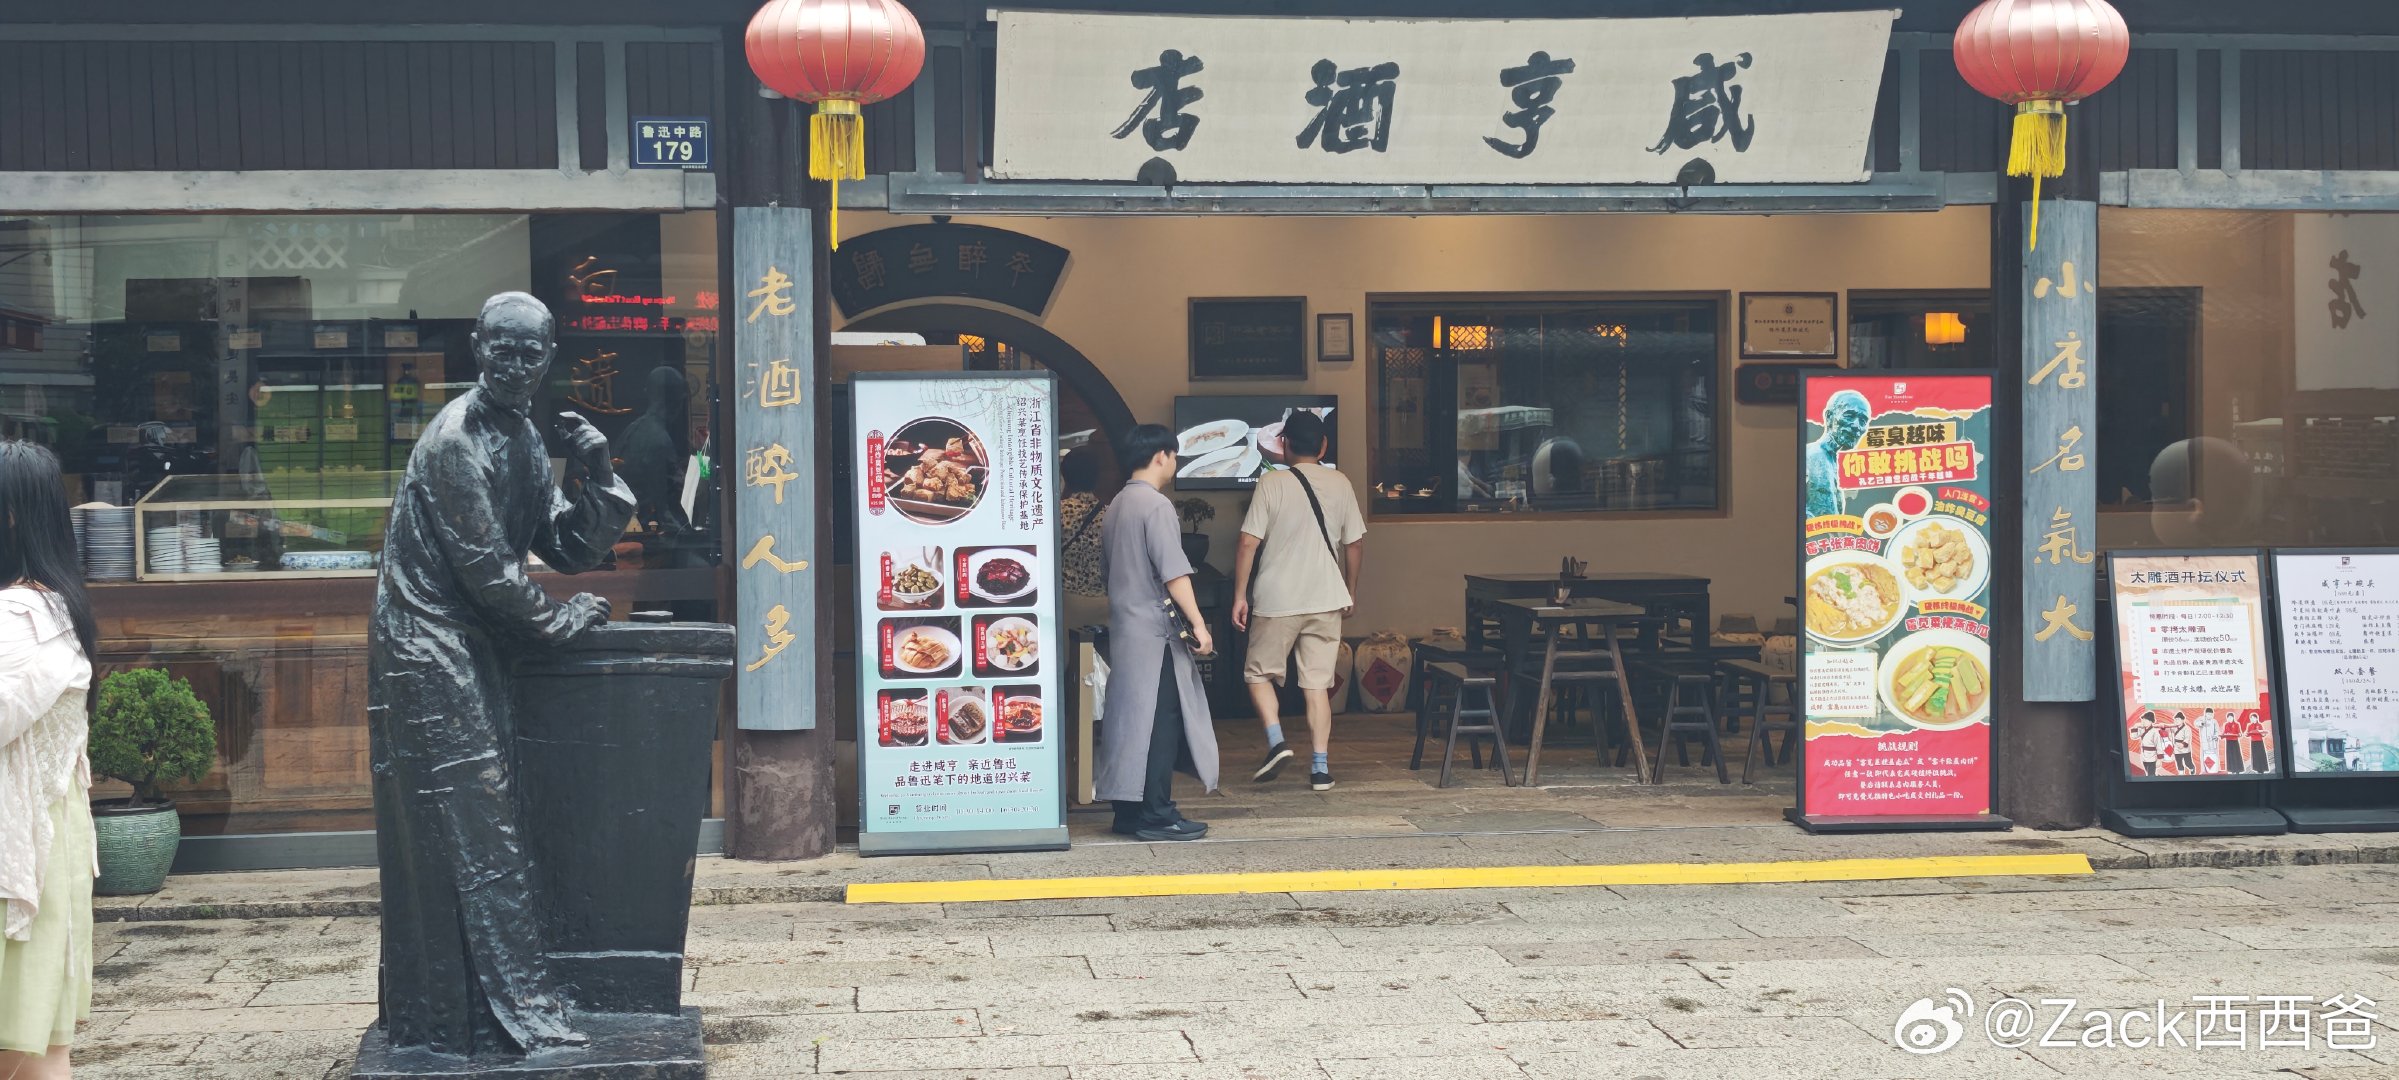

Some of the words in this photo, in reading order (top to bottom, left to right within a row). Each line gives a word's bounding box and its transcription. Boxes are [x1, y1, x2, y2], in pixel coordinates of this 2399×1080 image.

[642, 125, 702, 138] 鲁迅中路
[653, 141, 693, 160] 179
[1866, 424, 1945, 448] 霉臭越味
[742, 266, 808, 672] 老酒醉人多
[1016, 397, 1030, 531] 绍兴菜烹饪技艺传承保护基地
[1029, 397, 1044, 531] 浙江省非物质文化遗产
[1842, 445, 1969, 478] 你敢挑战吗
[1934, 501, 1987, 526] 油炸臭豆腐
[1806, 537, 1881, 555] 霉千张蒸肉饼
[2131, 570, 2247, 584] 太雕酒开坛仪式
[1905, 616, 1990, 639] 霉苋菜梗蒸南瓜
[1877, 741, 1919, 751] 挑战规则
[909, 760, 958, 773] 走进咸亨
[967, 758, 1017, 771] 亲近鲁迅
[895, 771, 1032, 787] 品鲁迅笔下的地道绍兴菜
